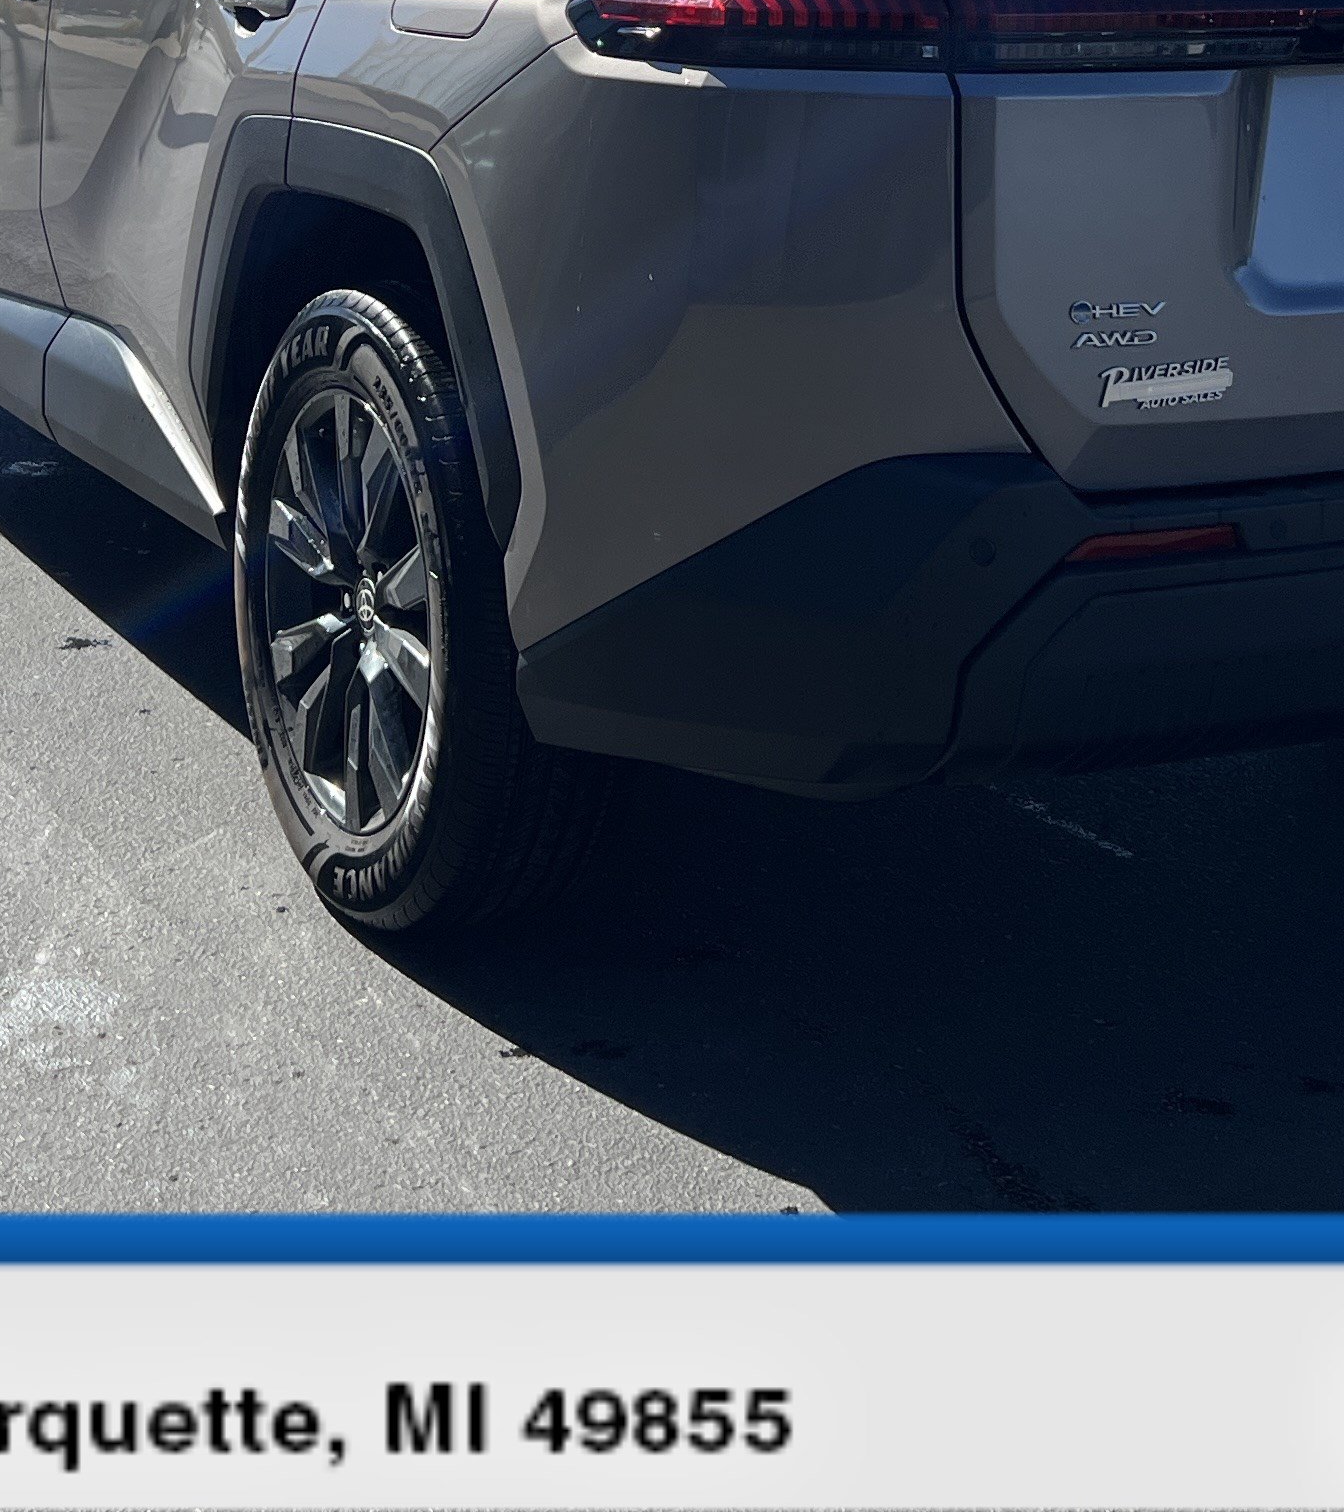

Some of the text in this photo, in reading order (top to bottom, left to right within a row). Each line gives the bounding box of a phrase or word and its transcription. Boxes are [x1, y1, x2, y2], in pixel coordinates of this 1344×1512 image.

[1071, 329, 1158, 349] AWD
[1138, 389, 1224, 411] AUTO SALES
